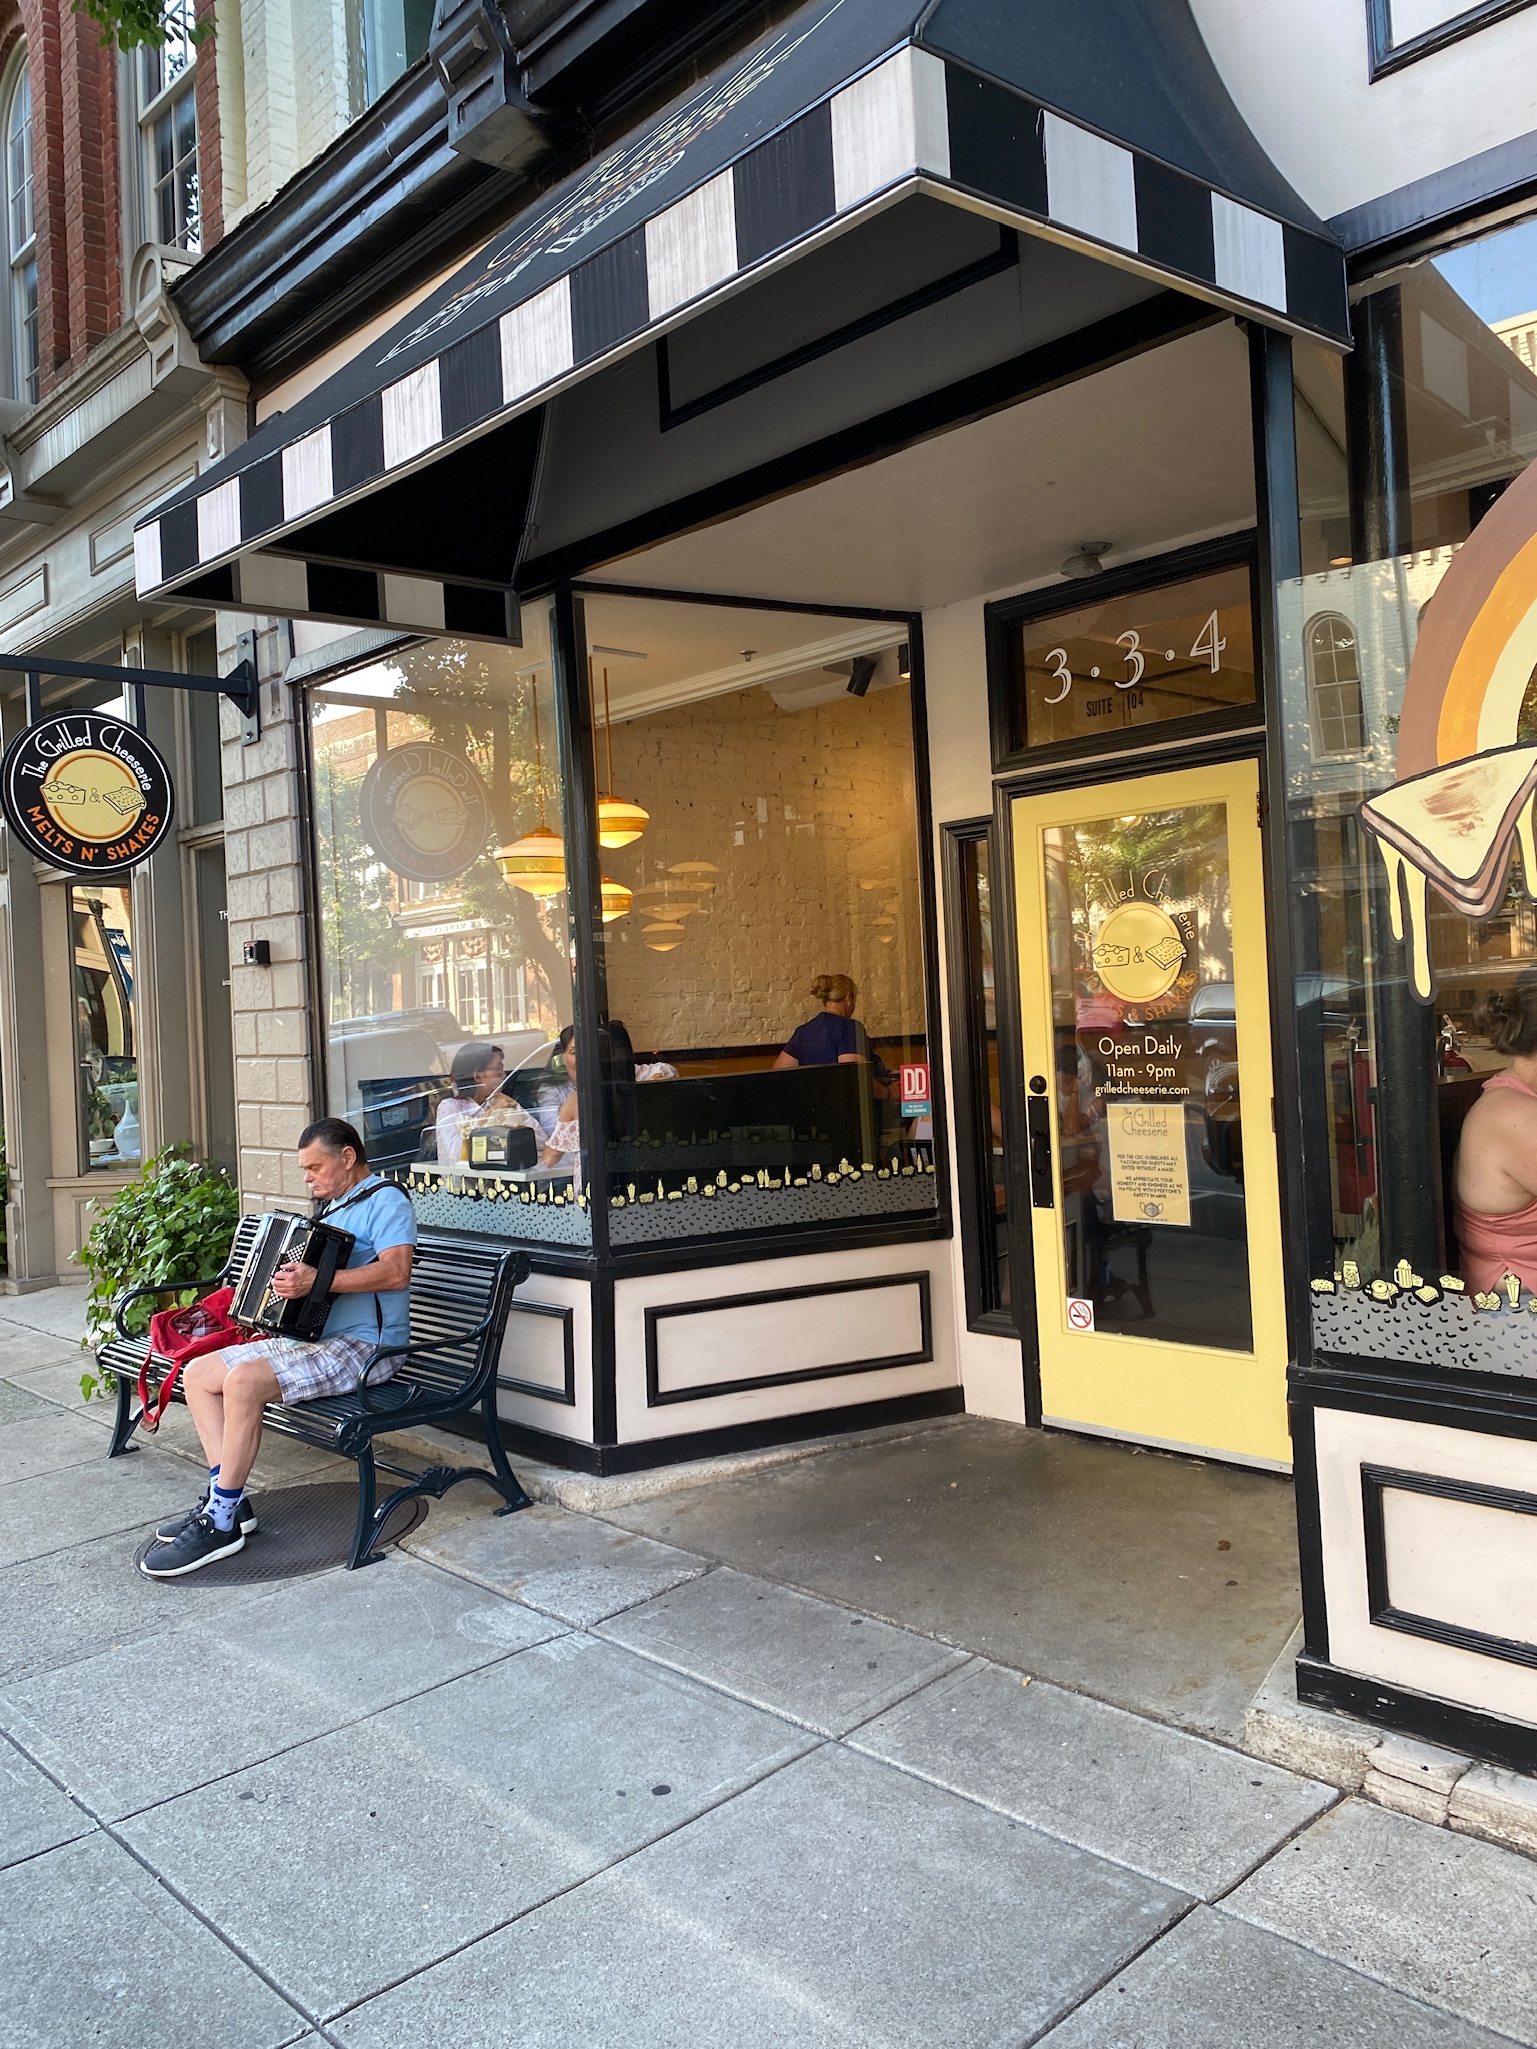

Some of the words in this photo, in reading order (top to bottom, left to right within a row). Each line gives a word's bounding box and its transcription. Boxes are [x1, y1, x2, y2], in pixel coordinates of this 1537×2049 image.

[1086, 697, 1113, 718] SUITE
[1126, 692, 1144, 710] 104
[21, 760, 49, 779] The
[35, 720, 92, 758] Grilled
[99, 725, 152, 791] Cheeserie
[27, 805, 75, 855] MELTS
[106, 813, 160, 861] SHAKES
[1098, 1036, 1140, 1060] Open
[1144, 1035, 1182, 1060] Daily
[903, 1067, 927, 1095] DD
[1106, 1063, 1135, 1077] 11am
[1146, 1063, 1176, 1081] 9pm
[1095, 1081, 1190, 1097] grilledcheeserie.com
[1122, 1115, 1168, 1136] Cheeserie
[1123, 1107, 1132, 1116] The
[1133, 1107, 1167, 1128] Grilled
